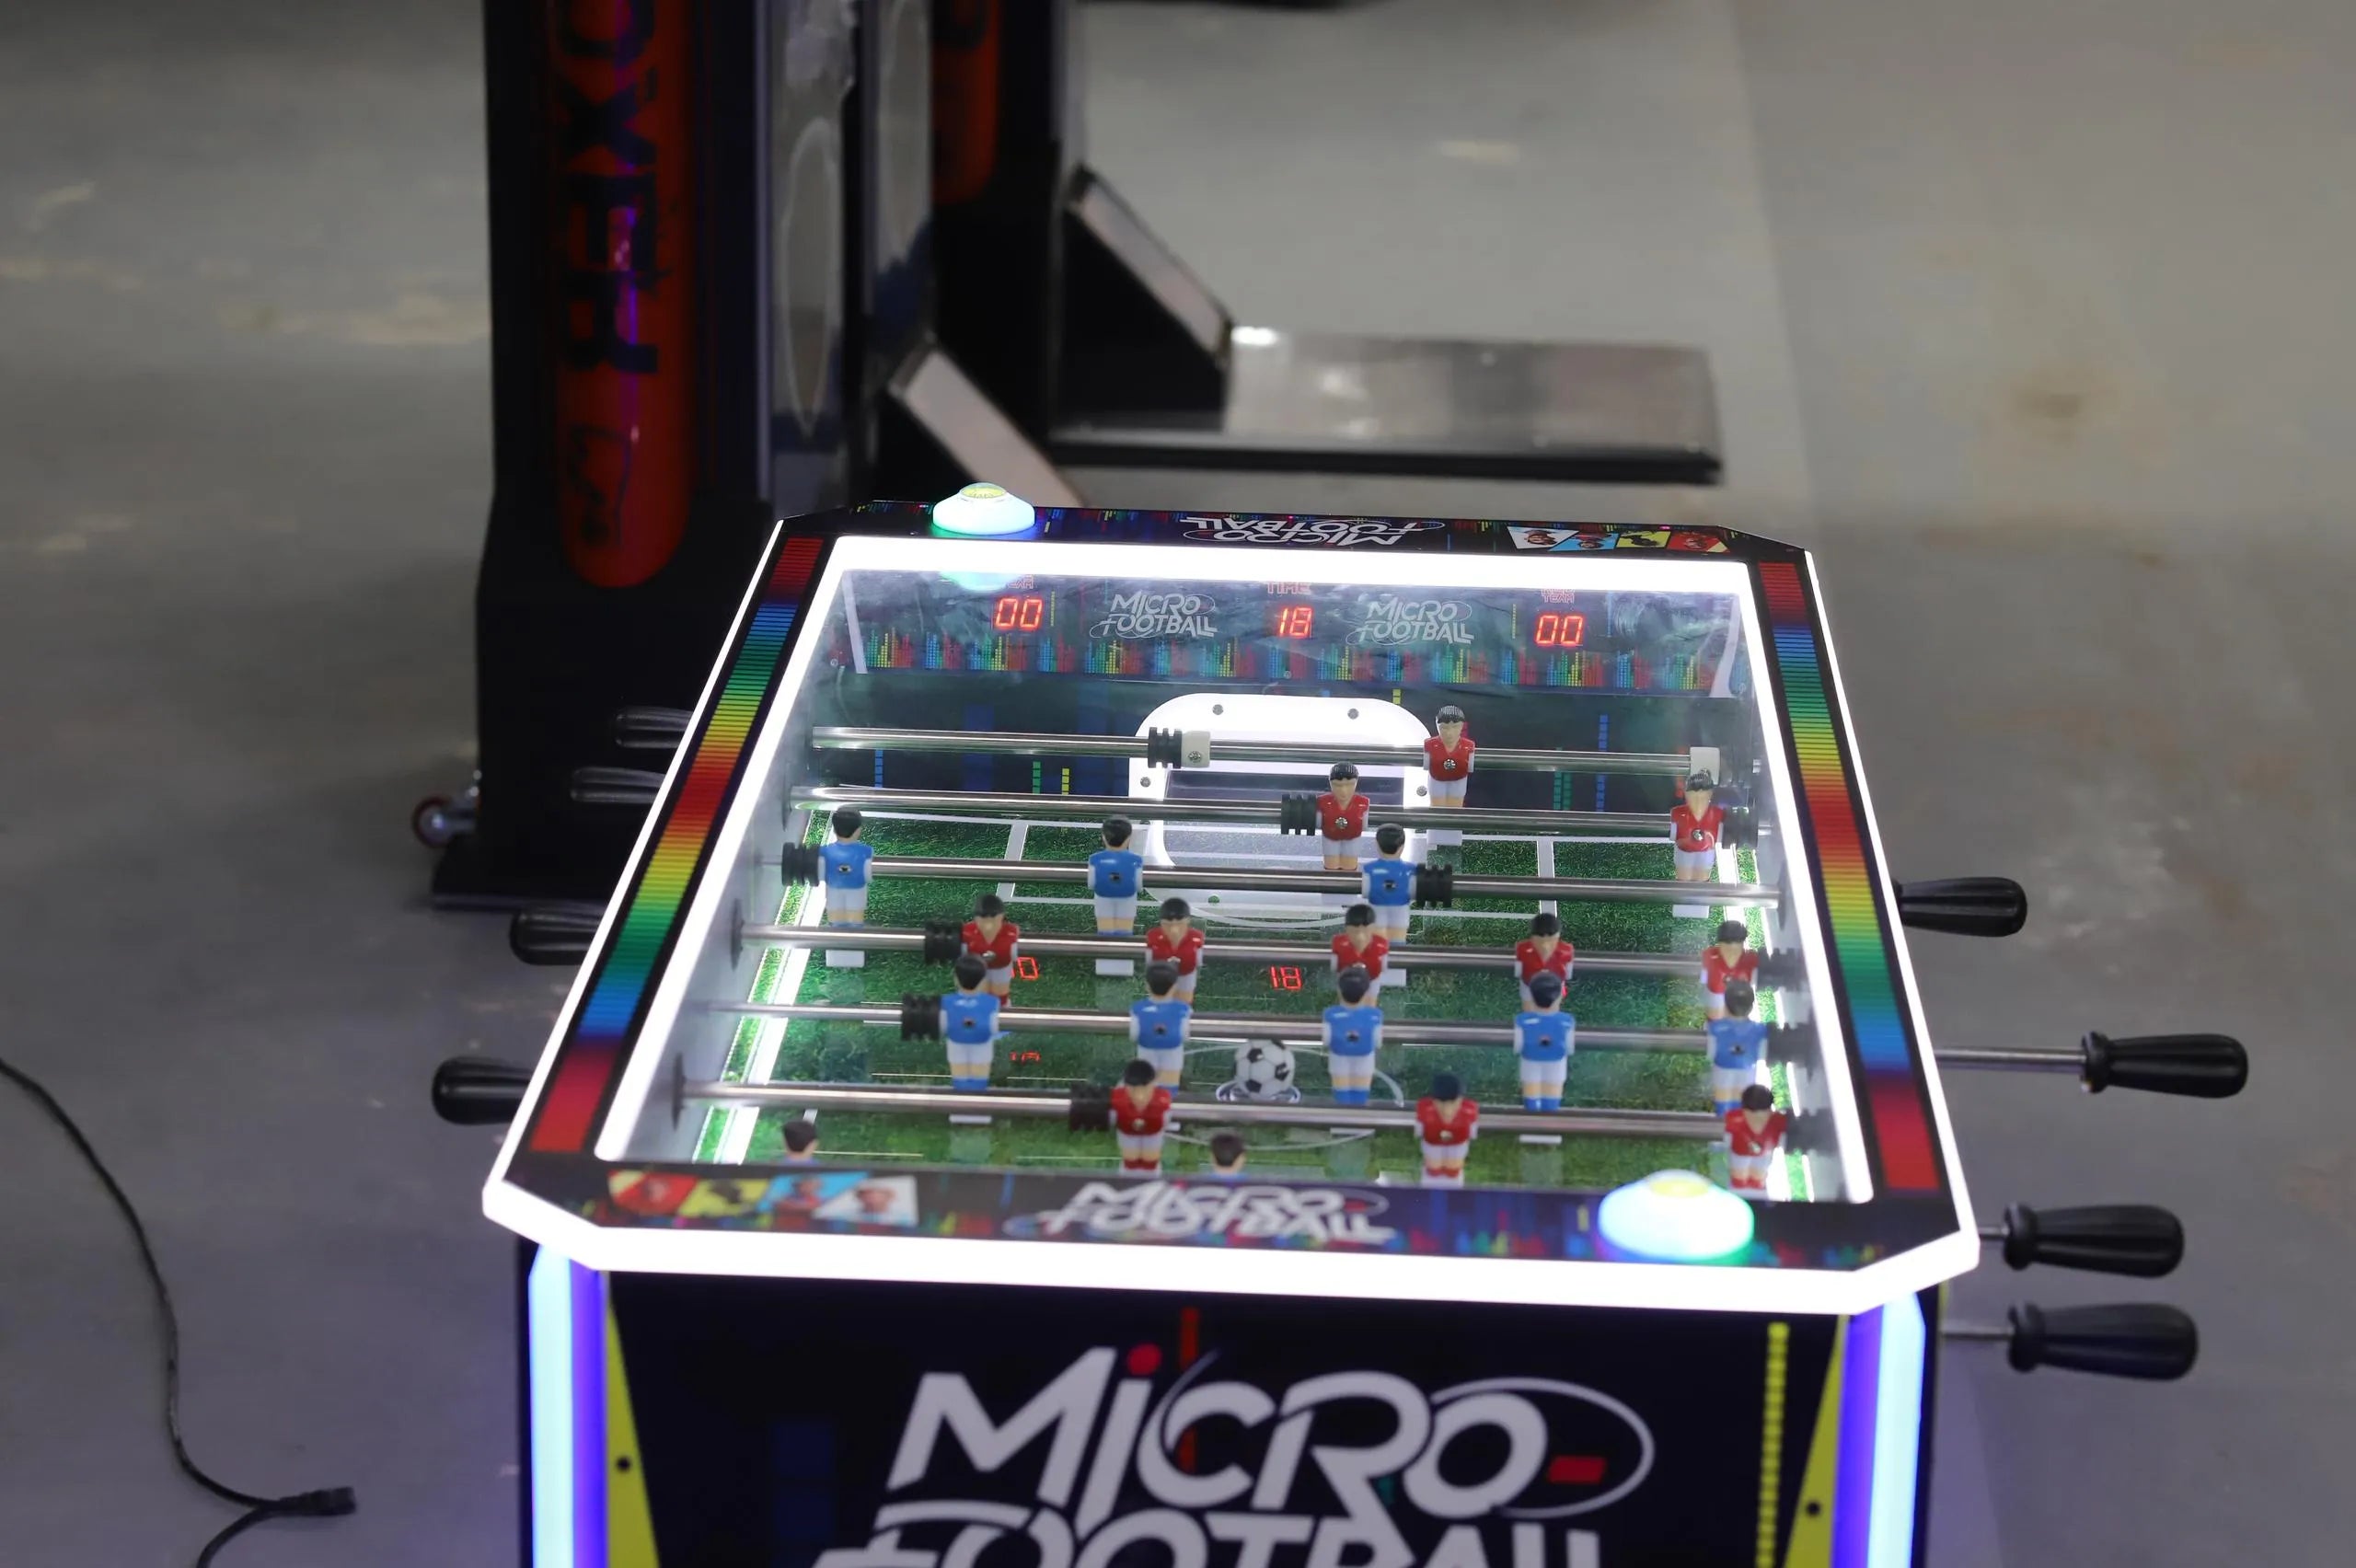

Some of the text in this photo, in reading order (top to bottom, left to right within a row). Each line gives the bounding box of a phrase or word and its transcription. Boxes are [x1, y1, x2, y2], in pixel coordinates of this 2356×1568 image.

[1179, 517, 1424, 535] FOOTBALL
[1213, 528, 1403, 546] MICRO
[995, 596, 1043, 629] 00
[1110, 591, 1201, 617] MICRO
[1366, 597, 1457, 625] MICRO
[1100, 614, 1218, 638] FOOTBALL
[1278, 606, 1313, 638] 18
[1354, 621, 1474, 644] FOOTBALL
[1535, 614, 1584, 646] 00
[886, 1345, 1555, 1541] MICRO
